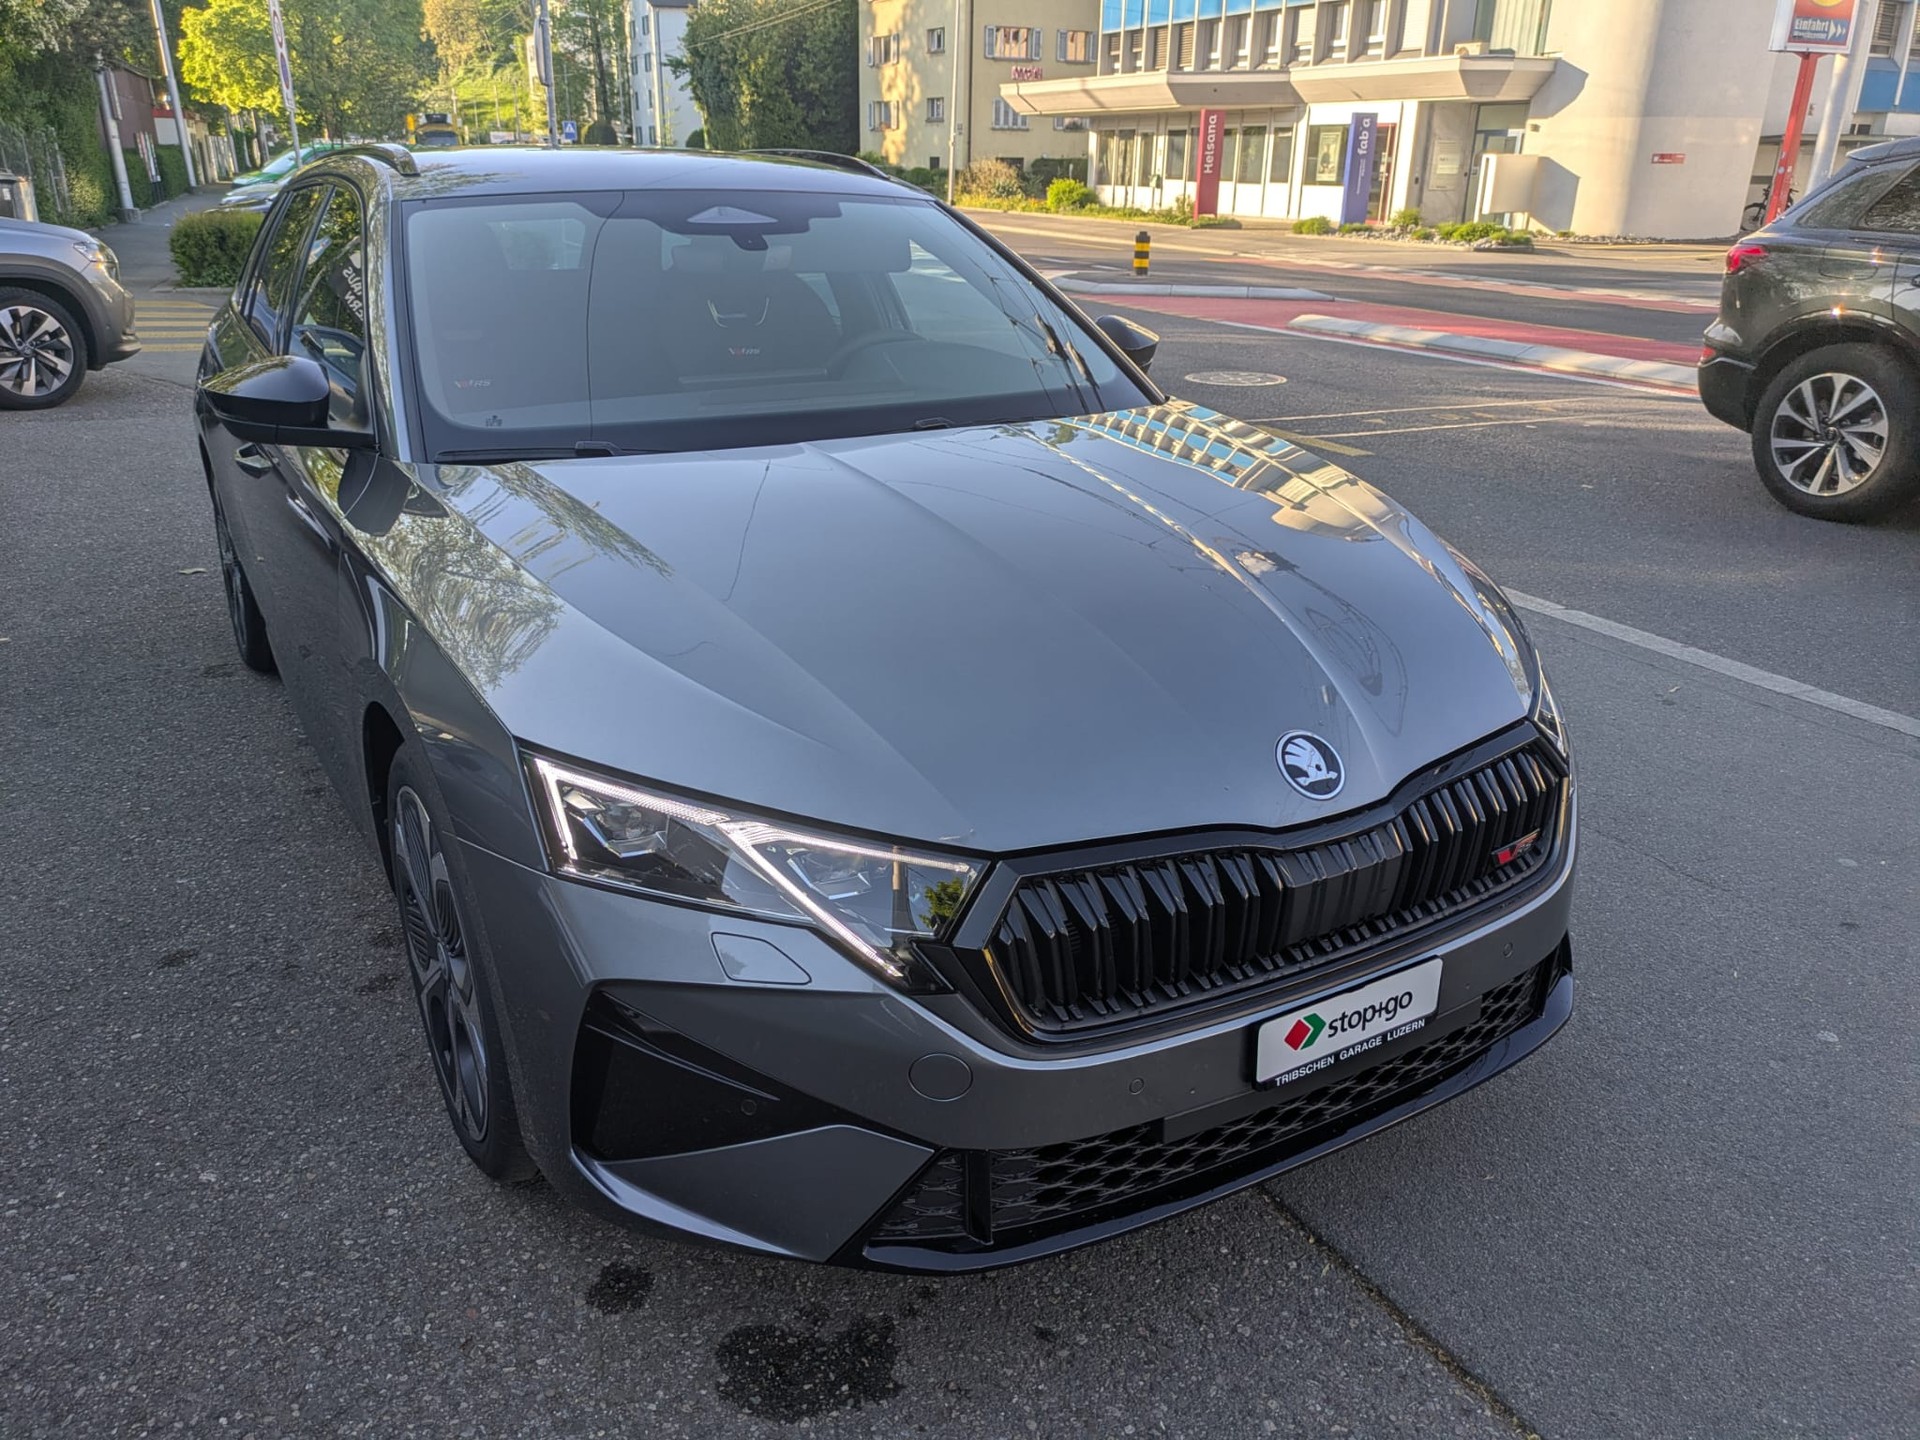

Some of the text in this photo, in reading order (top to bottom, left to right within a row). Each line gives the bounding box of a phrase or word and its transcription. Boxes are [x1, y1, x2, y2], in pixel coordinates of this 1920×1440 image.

[1794, 17, 1830, 32] Einfahrt
[1203, 114, 1217, 174] Helsana
[1327, 991, 1413, 1039] stop+go
[1275, 1019, 1425, 1087] TRIBSCHEN GARAGE LUZERN
